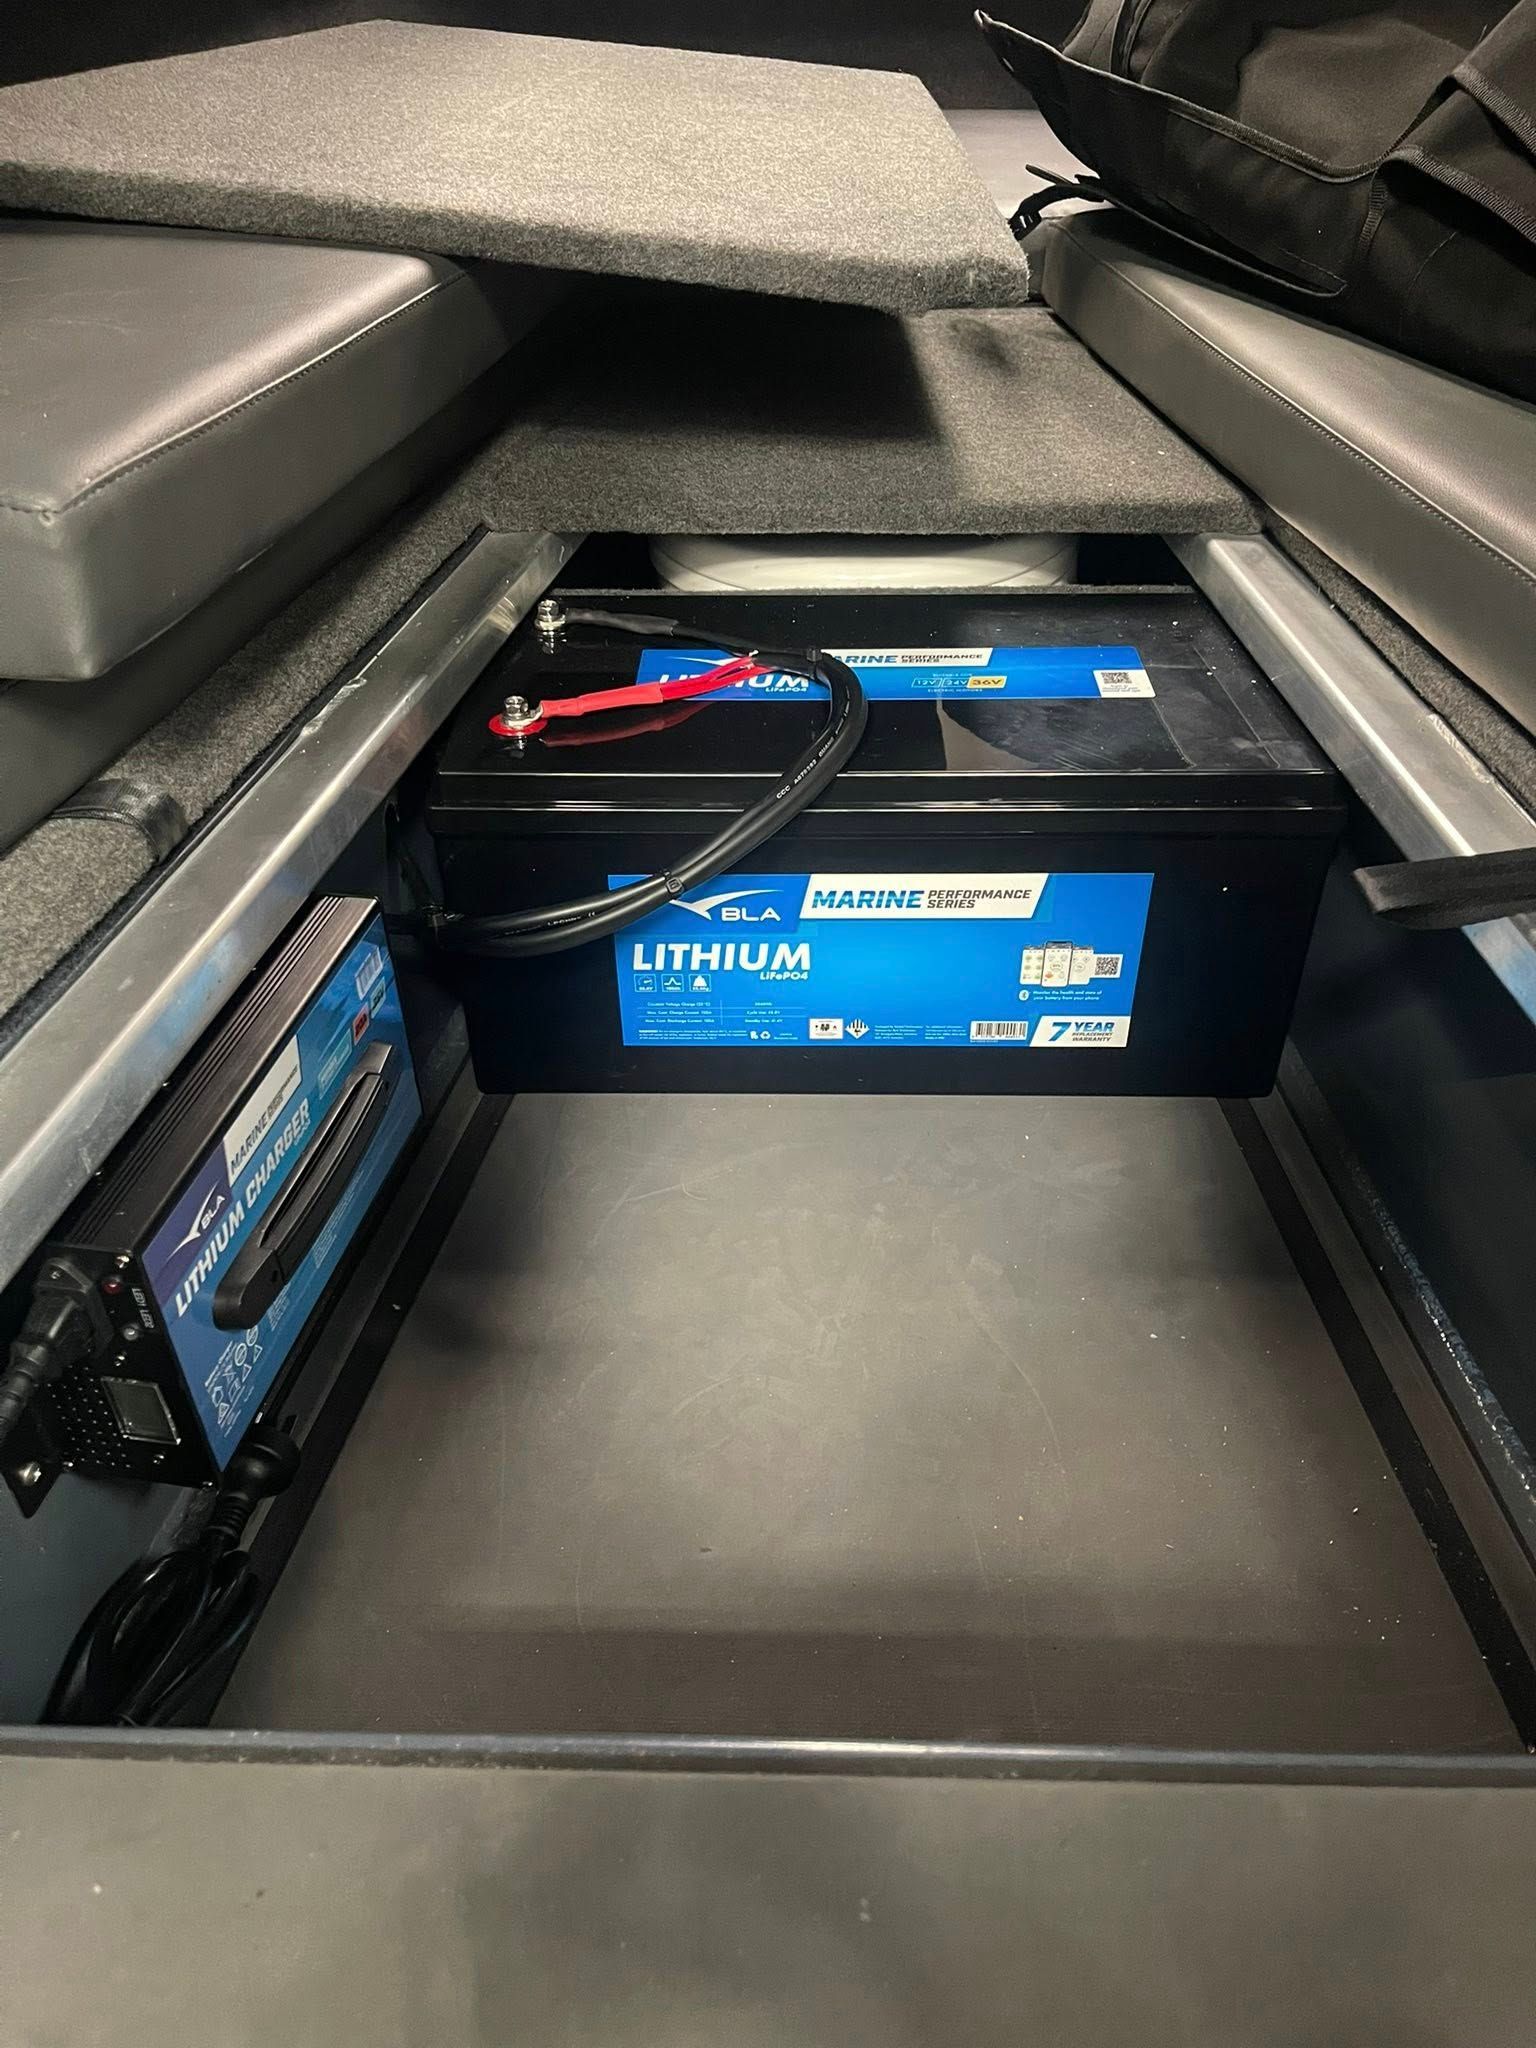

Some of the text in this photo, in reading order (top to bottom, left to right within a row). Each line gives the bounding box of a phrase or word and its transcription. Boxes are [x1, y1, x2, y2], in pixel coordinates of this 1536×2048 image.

[833, 655, 899, 664] RINE
[776, 784, 791, 799] CCC
[811, 889, 1033, 909] MARINE PERFORMANCE
[927, 898, 976, 909] SERIES
[721, 907, 781, 921] BLA
[632, 942, 811, 971] LITHIUM
[759, 971, 809, 981] LiFePO4
[1048, 1022, 1115, 1041] 7 YEAR
[230, 1111, 268, 1175] MARINE
[175, 1200, 245, 1318] LITHIUM
[245, 1097, 311, 1208] CHARGER
[200, 1195, 225, 1230] BLA
